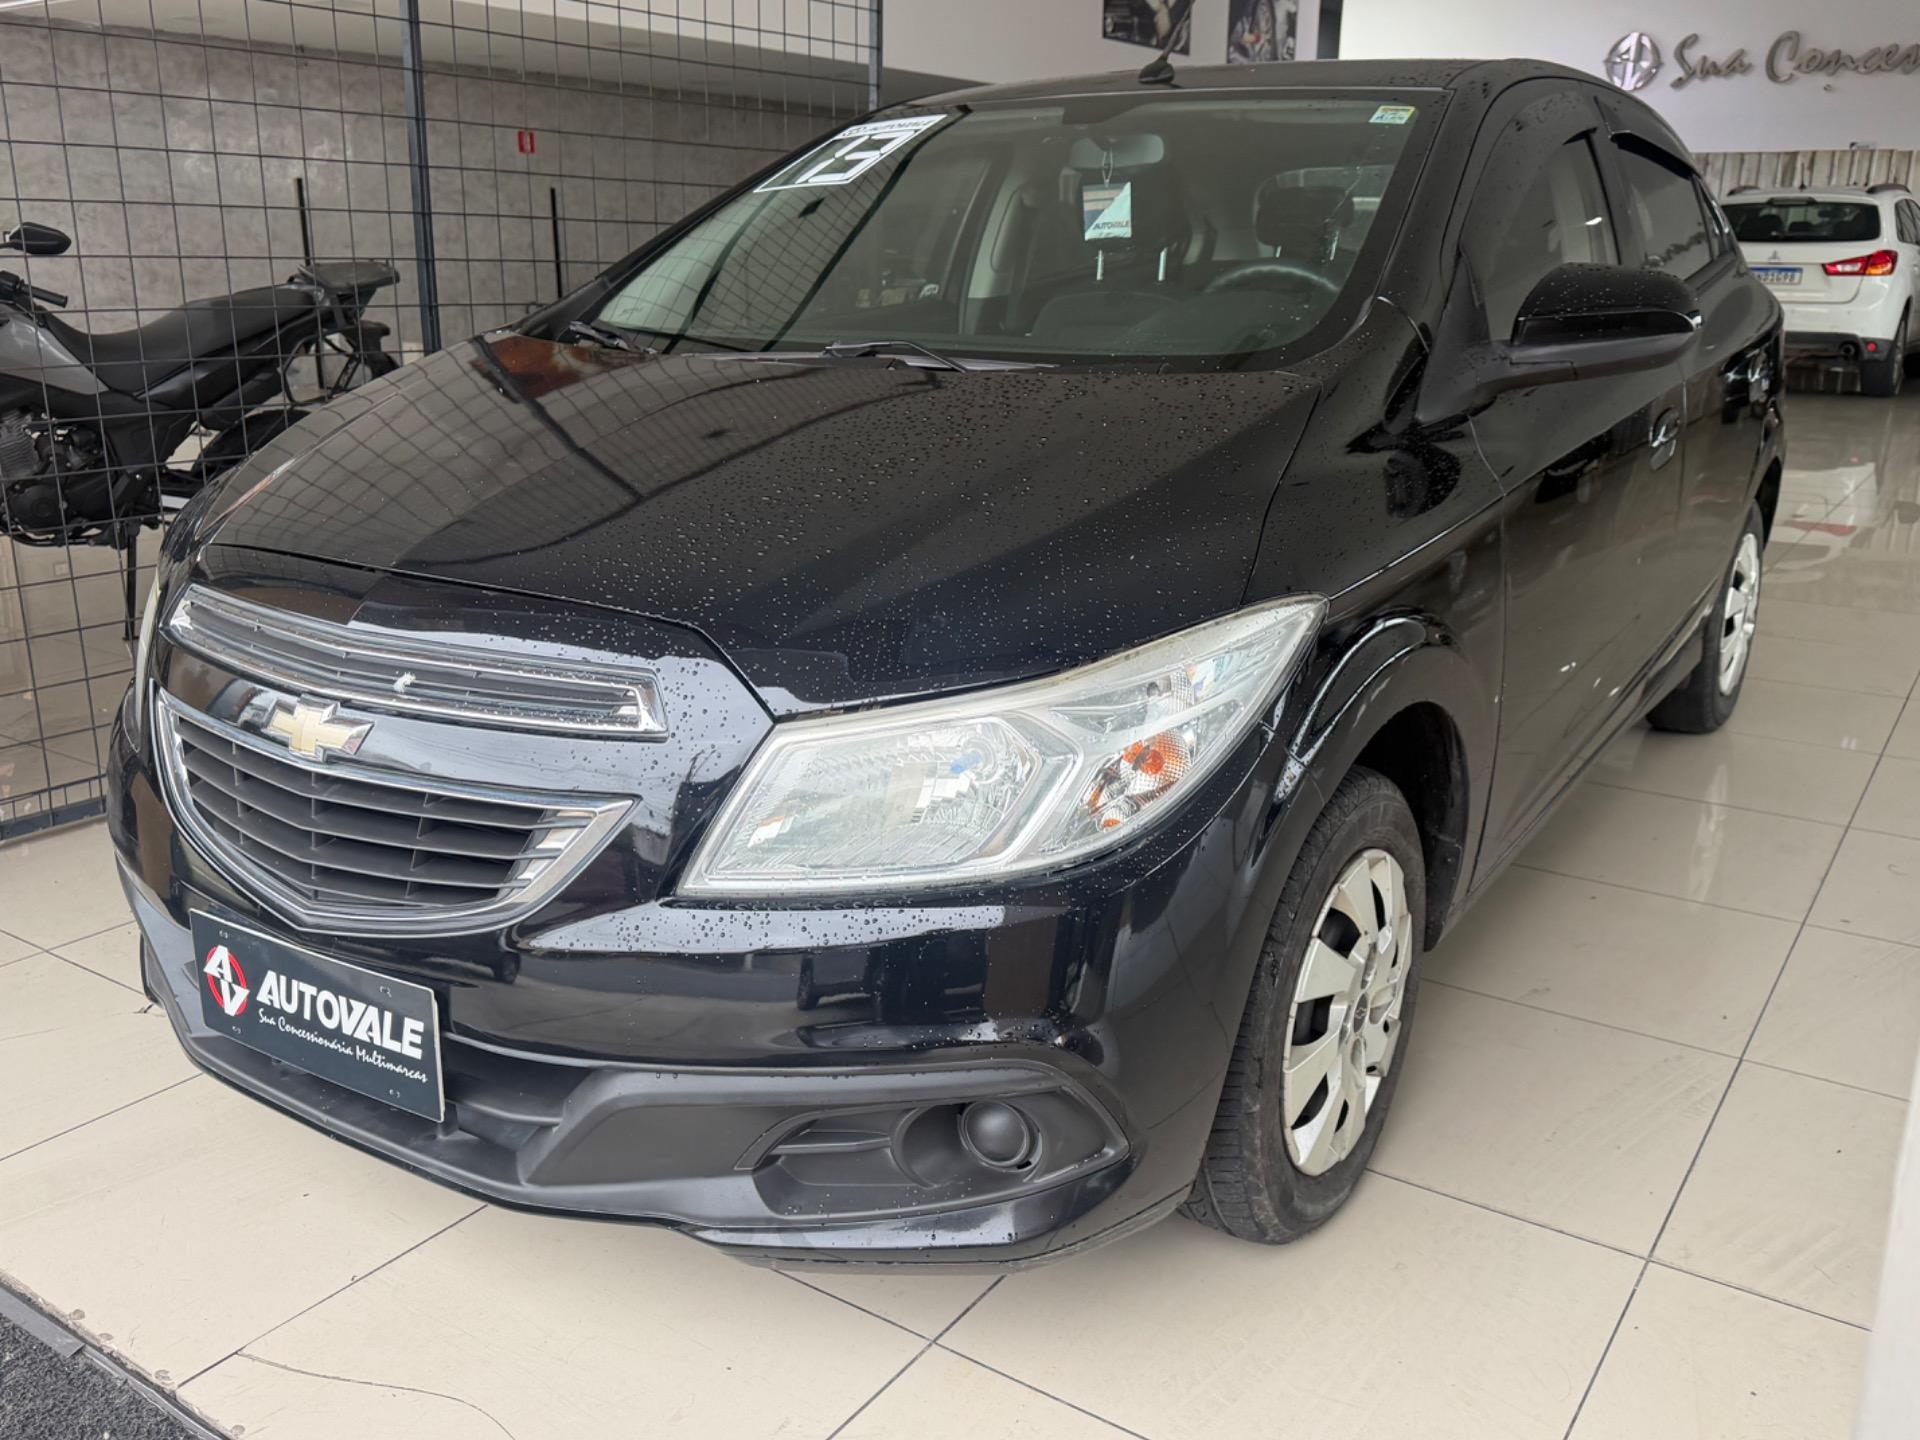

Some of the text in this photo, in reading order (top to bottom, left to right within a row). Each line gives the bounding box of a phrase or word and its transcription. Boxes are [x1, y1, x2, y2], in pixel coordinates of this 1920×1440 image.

[1669, 33, 1754, 88] Sua
[256, 970, 425, 1060] AUTOVALE
[258, 1007, 428, 1083] Sua Concessionária Multimarcas
